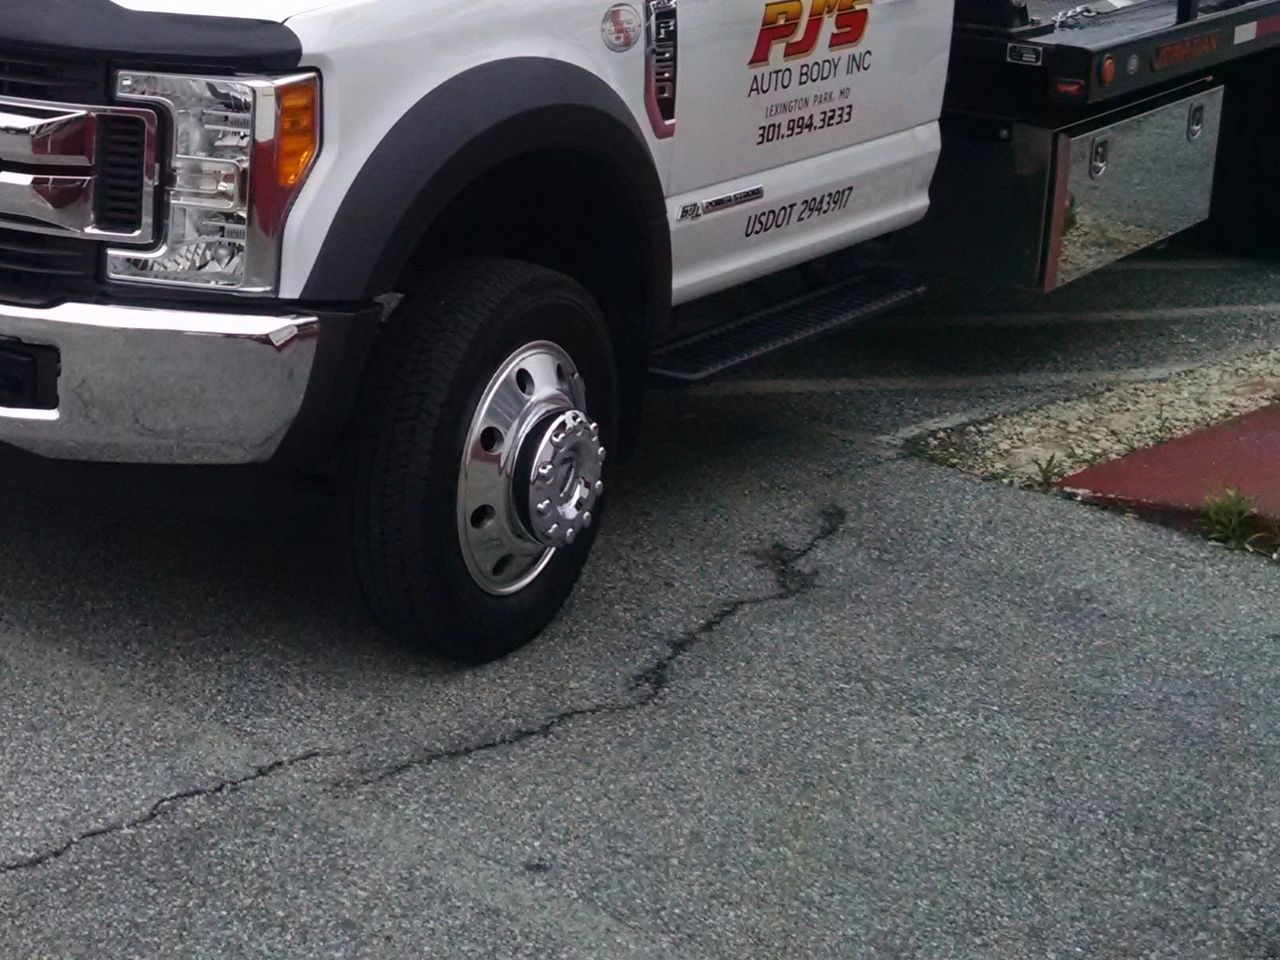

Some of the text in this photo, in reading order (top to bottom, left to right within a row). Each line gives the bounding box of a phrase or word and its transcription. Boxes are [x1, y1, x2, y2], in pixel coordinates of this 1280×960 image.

[747, 50, 873, 98] AUTO BODY INC
[755, 104, 854, 146] 301.994.3233
[765, 96, 809, 119] LEXINGTON
[839, 87, 851, 99] MD
[744, 186, 855, 238] USDOT 2943917
